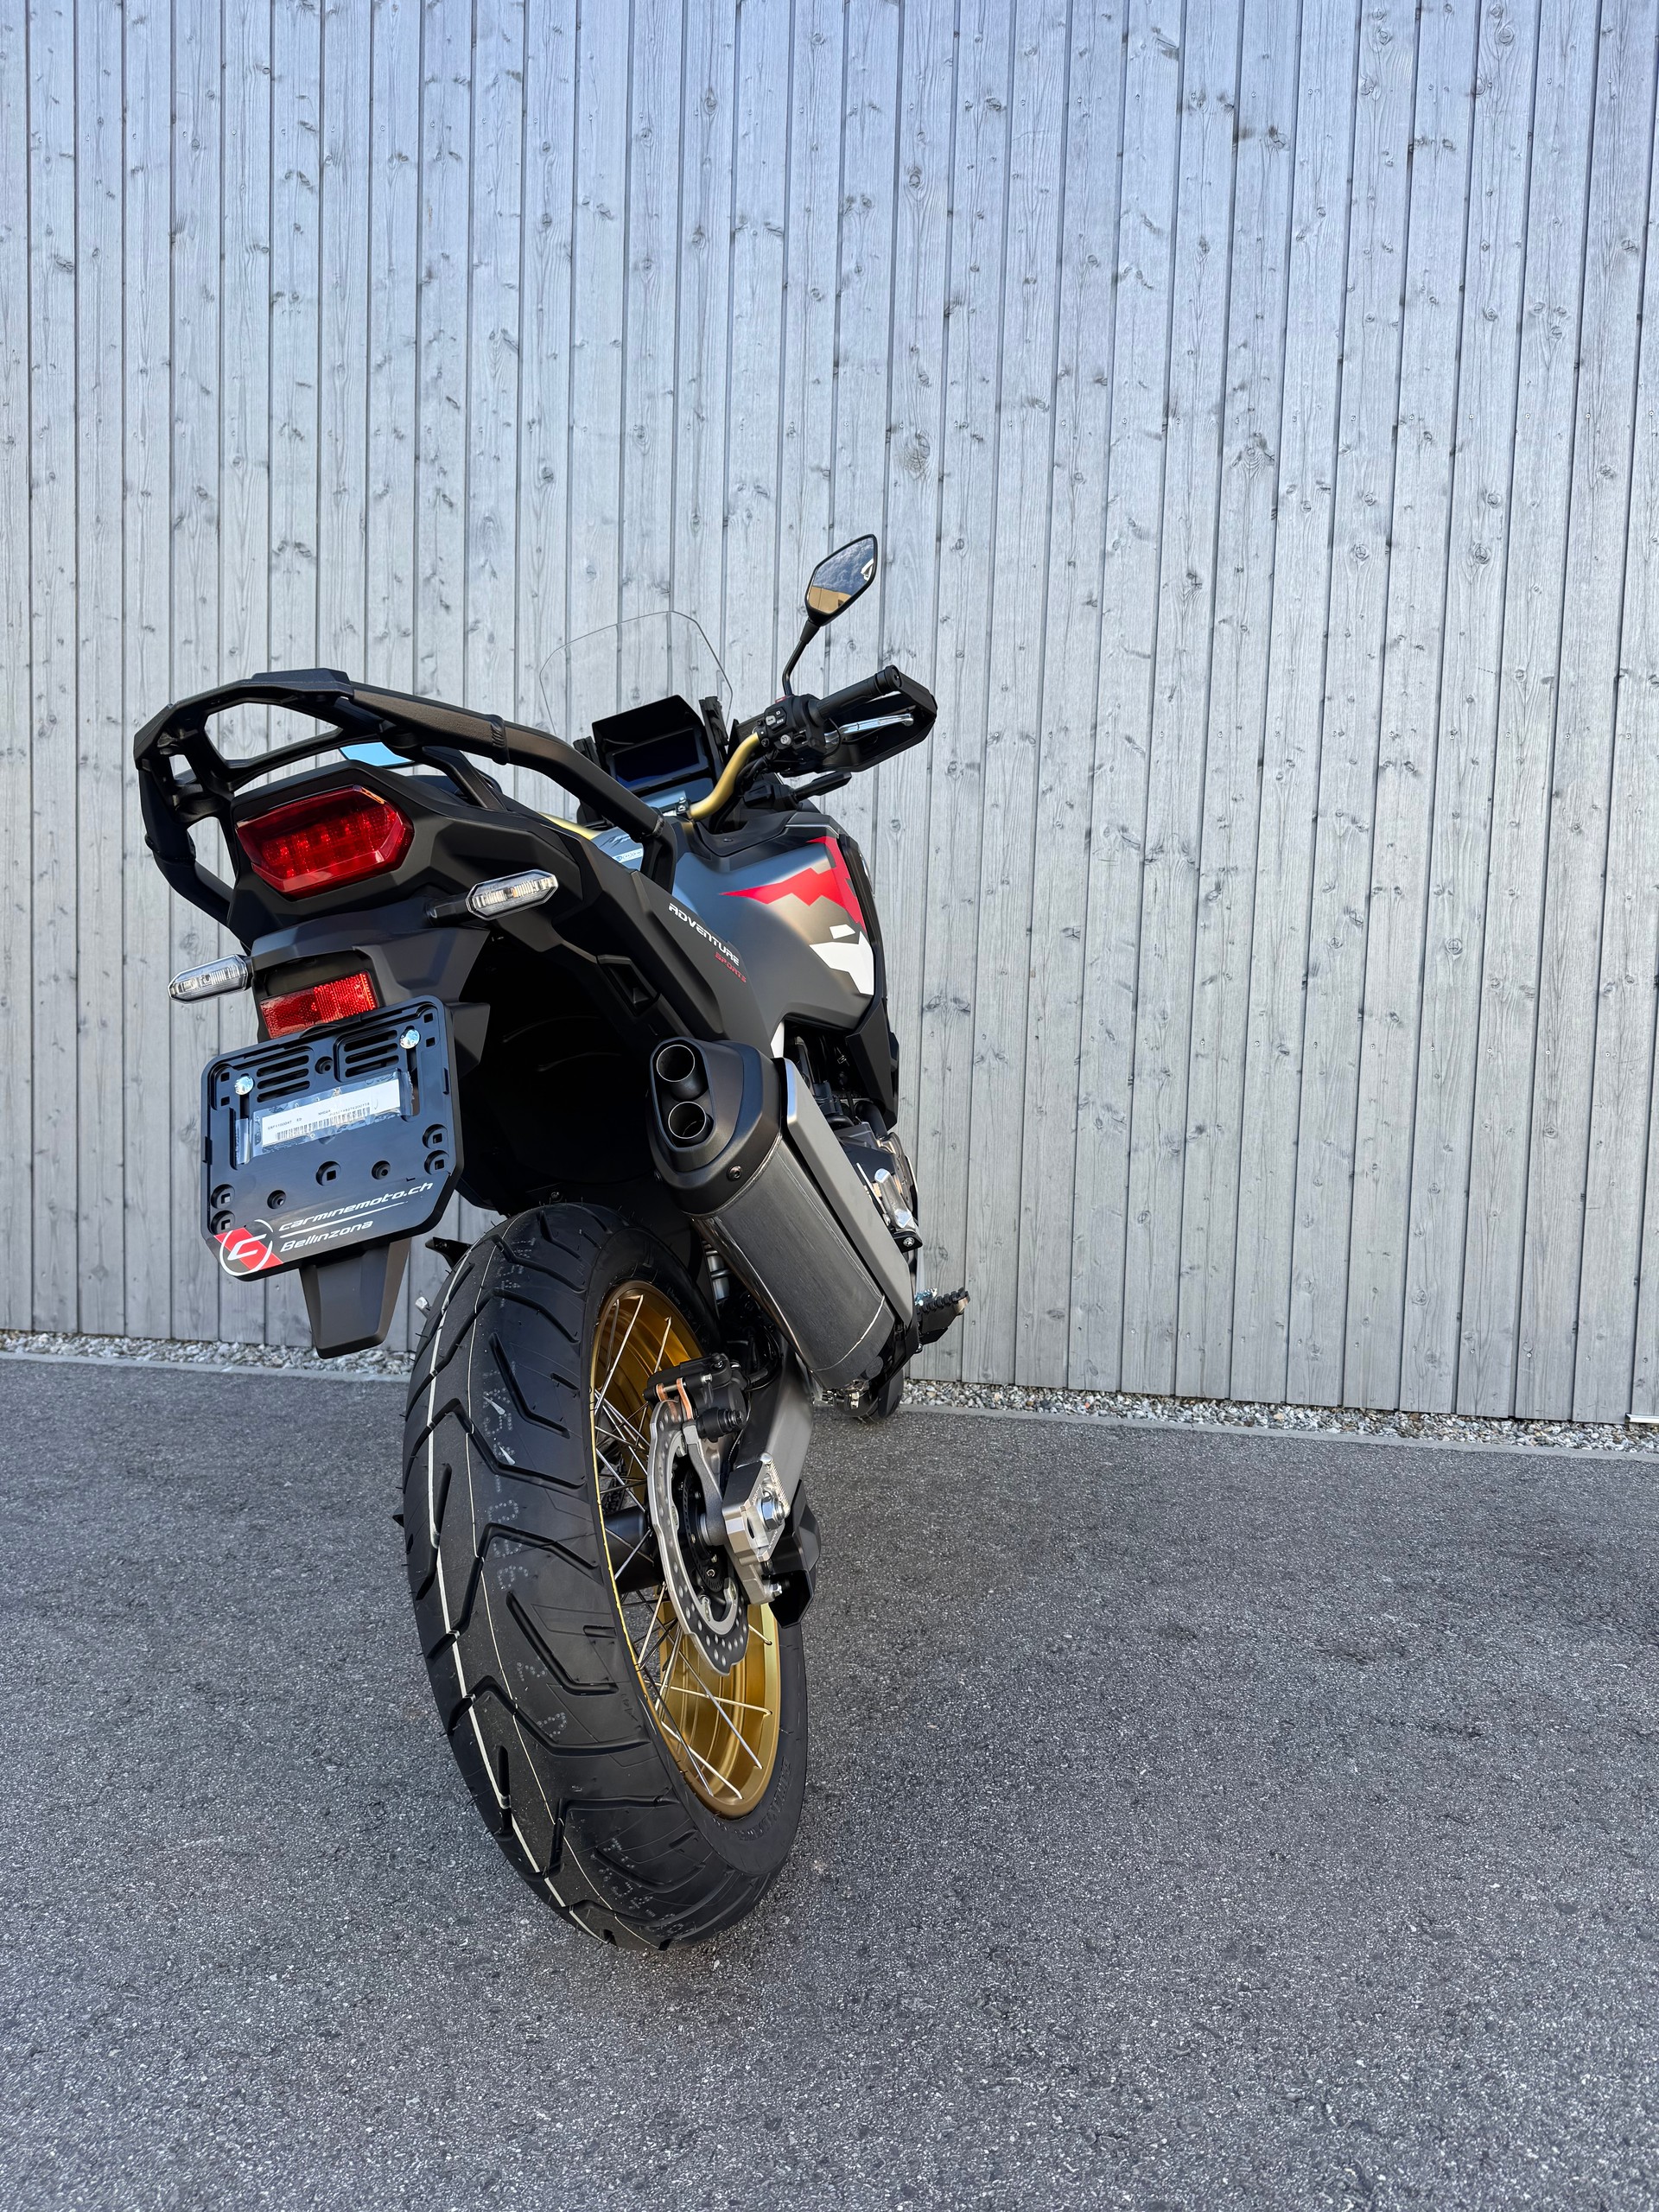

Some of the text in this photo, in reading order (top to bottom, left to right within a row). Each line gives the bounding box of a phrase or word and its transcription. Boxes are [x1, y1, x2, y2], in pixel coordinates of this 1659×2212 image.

[668, 902, 740, 967] ADVENTURE
[715, 951, 747, 983] SPORTS
[278, 1182, 434, 1232] carminemoto.ch
[279, 1220, 374, 1253] Bellinzona
